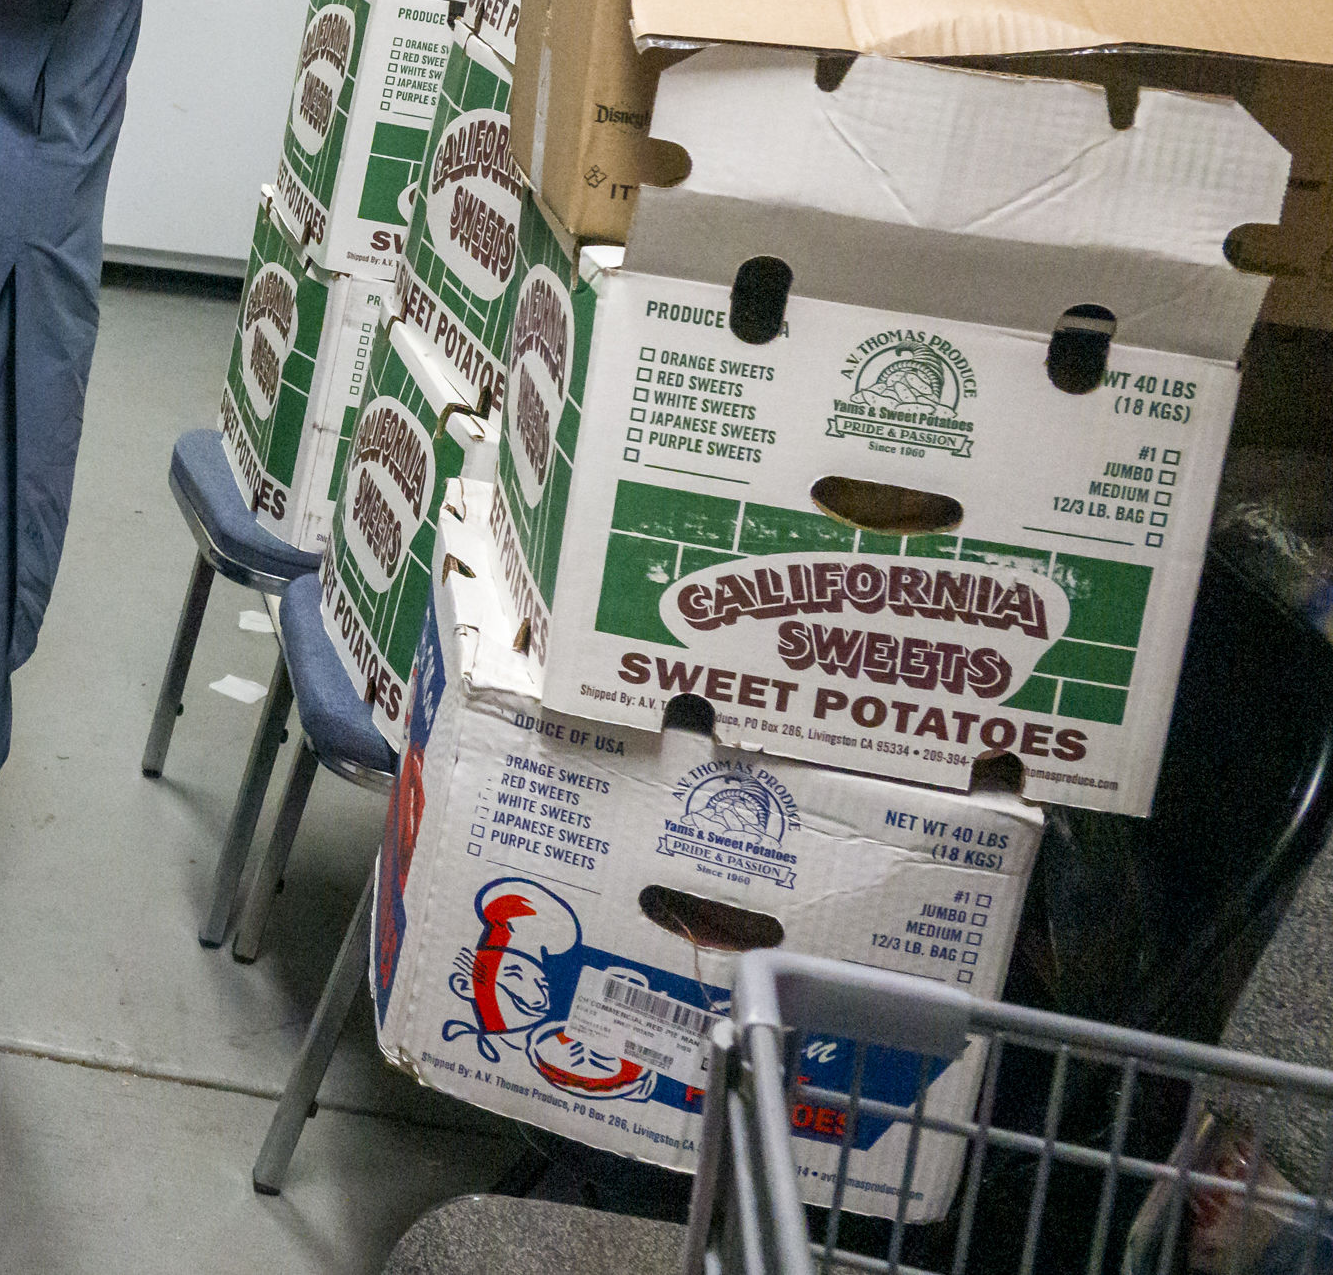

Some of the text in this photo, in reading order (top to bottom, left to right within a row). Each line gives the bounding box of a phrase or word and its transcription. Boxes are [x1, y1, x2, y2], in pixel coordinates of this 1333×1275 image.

[398, 7, 446, 25] PRODUCE
[402, 51, 419, 63] RED
[405, 39, 439, 53] ORANGE
[397, 77, 438, 92] JAPANESE
[400, 64, 426, 78] WHITE
[396, 90, 429, 105] PURPLE
[284, 177, 327, 245] POTATOES
[450, 184, 516, 283] SWEETS
[646, 300, 726, 329] PRODUCE
[661, 350, 775, 381] ORANGE SWEETS
[841, 329, 978, 399] A.V. THOMAS PRODUCE
[656, 370, 744, 398] RED SWEETS
[1134, 375, 1158, 394] 40
[1161, 379, 1197, 400] LBS
[654, 390, 756, 421] WHITE SWEETS
[833, 399, 974, 433] Yams & Sweet Potatoes
[1114, 396, 1191, 424] (18 KGS)
[649, 411, 776, 445] JAPANESE SWEETS
[842, 421, 957, 447] PRIDE & PASSION
[648, 431, 763, 463] PURPLE SWEETS
[868, 440, 926, 459] Since 1960
[1139, 445, 1157, 462] #1
[235, 429, 287, 522] POTATOES
[352, 407, 428, 522] CALIFORNIA
[1103, 461, 1153, 482] JUMBO
[1089, 480, 1150, 503] MEDIUM
[1053, 496, 1145, 524] 12/3 LB. BAG
[675, 561, 1051, 641] CALIFORNIA
[334, 589, 403, 723] POTATOES
[776, 618, 1013, 700] SWEETS
[618, 652, 1089, 762] SWEET POTATOES
[514, 713, 625, 756] ODUCE OF USA
[580, 684, 1119, 792] Shipped By: A.V. duce, PO Box 286, Livingston CA 95334 209-394- homasproduce.com
[500, 772, 581, 807] RED SWEETS
[506, 754, 611, 795] ORANGE SWEETS
[497, 791, 593, 830] WHITE SWEETS
[687, 759, 755, 782] THOMAS
[756, 768, 802, 832] PRODUCE
[492, 810, 611, 855] JAPANESE SWEETS
[664, 818, 798, 865] Yams & Sweet Potatoes
[885, 809, 1011, 851] NET WT 40 LBS
[490, 829, 597, 871] PURPLE SWEETS
[673, 840, 782, 878] PRIDE & PASSION
[931, 843, 1004, 871] (18 KGS)
[696, 863, 752, 886] Since 1960
[953, 890, 971, 905] #1
[919, 904, 968, 924] JUMBO
[871, 932, 959, 962] 12/3 LB. BAG
[905, 920, 963, 943] MEDIUM
[590, 1001, 643, 1027] COMMERCIAL
[680, 1034, 701, 1048] MAN
[421, 1051, 697, 1153] Shipped By: A.V. Thomas Produce, PO Box 286, Livingston CA
